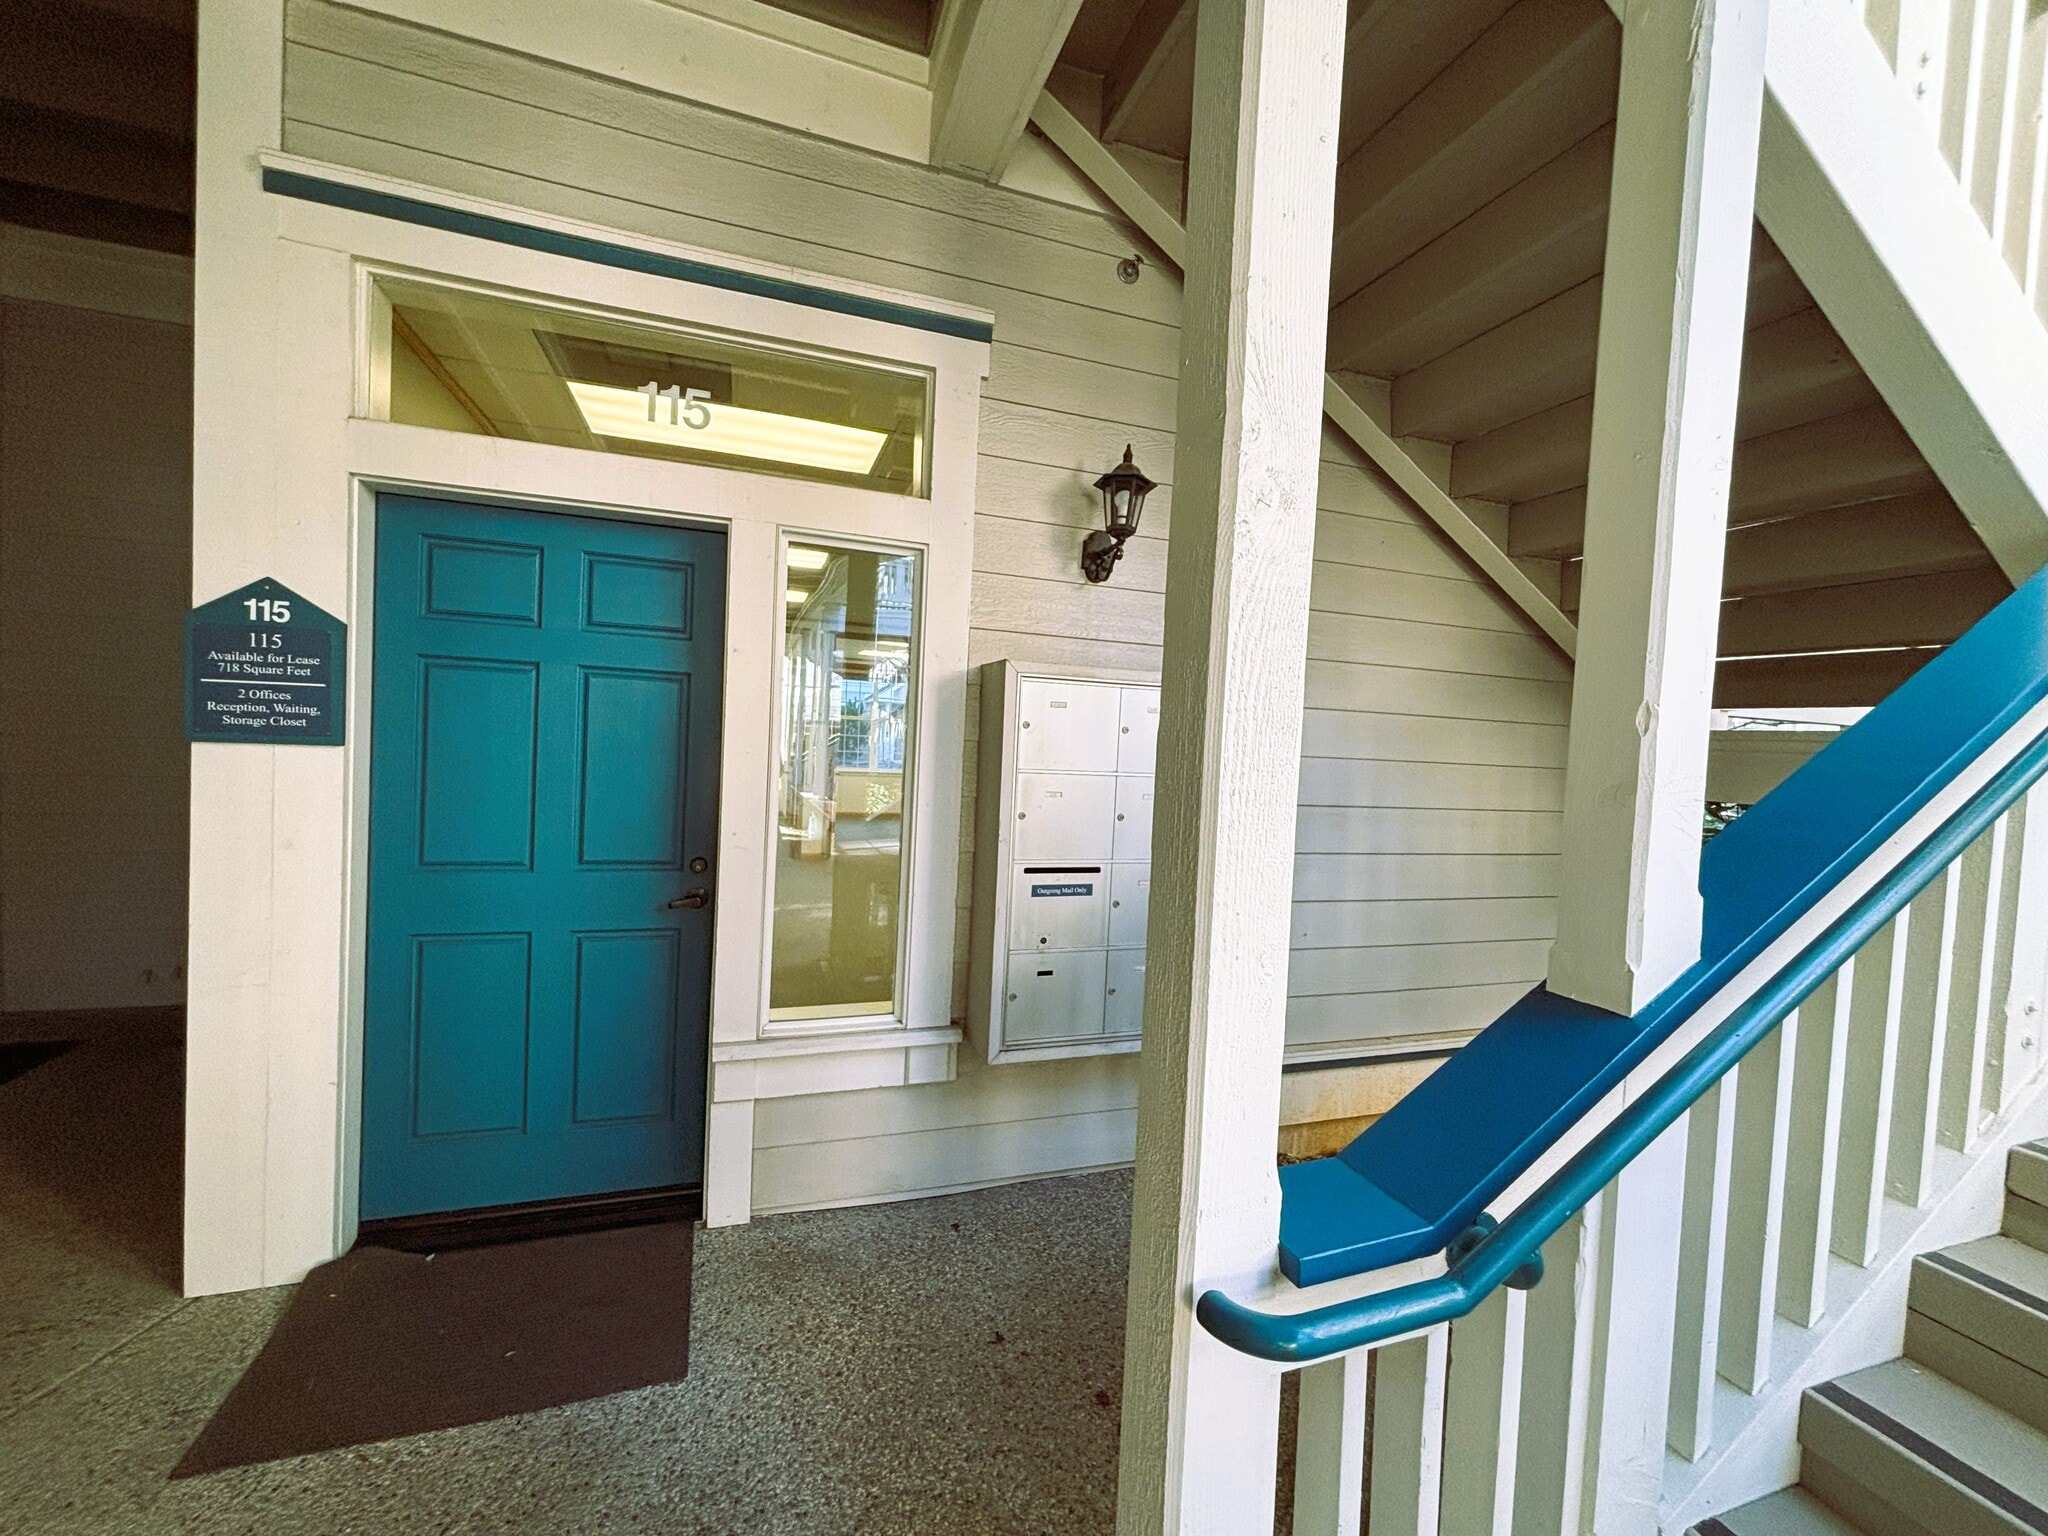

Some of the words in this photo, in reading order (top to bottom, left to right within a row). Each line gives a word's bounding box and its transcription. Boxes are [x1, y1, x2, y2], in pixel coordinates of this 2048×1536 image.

[637, 381, 711, 430] 115
[243, 598, 291, 623] 115
[249, 632, 282, 649] 115
[207, 650, 265, 663] Available
[267, 653, 285, 664] for
[287, 654, 321, 665] Lease
[217, 662, 240, 673] 718
[243, 663, 284, 676] Square
[286, 666, 312, 676] Feet
[237, 689, 246, 699] 2
[249, 689, 292, 700] Offices
[206, 701, 270, 714] Reception,
[273, 703, 321, 716] Waiting,
[222, 715, 267, 728] Storage
[269, 716, 307, 727] Closet
[1037, 887, 1061, 895] Outgoing
